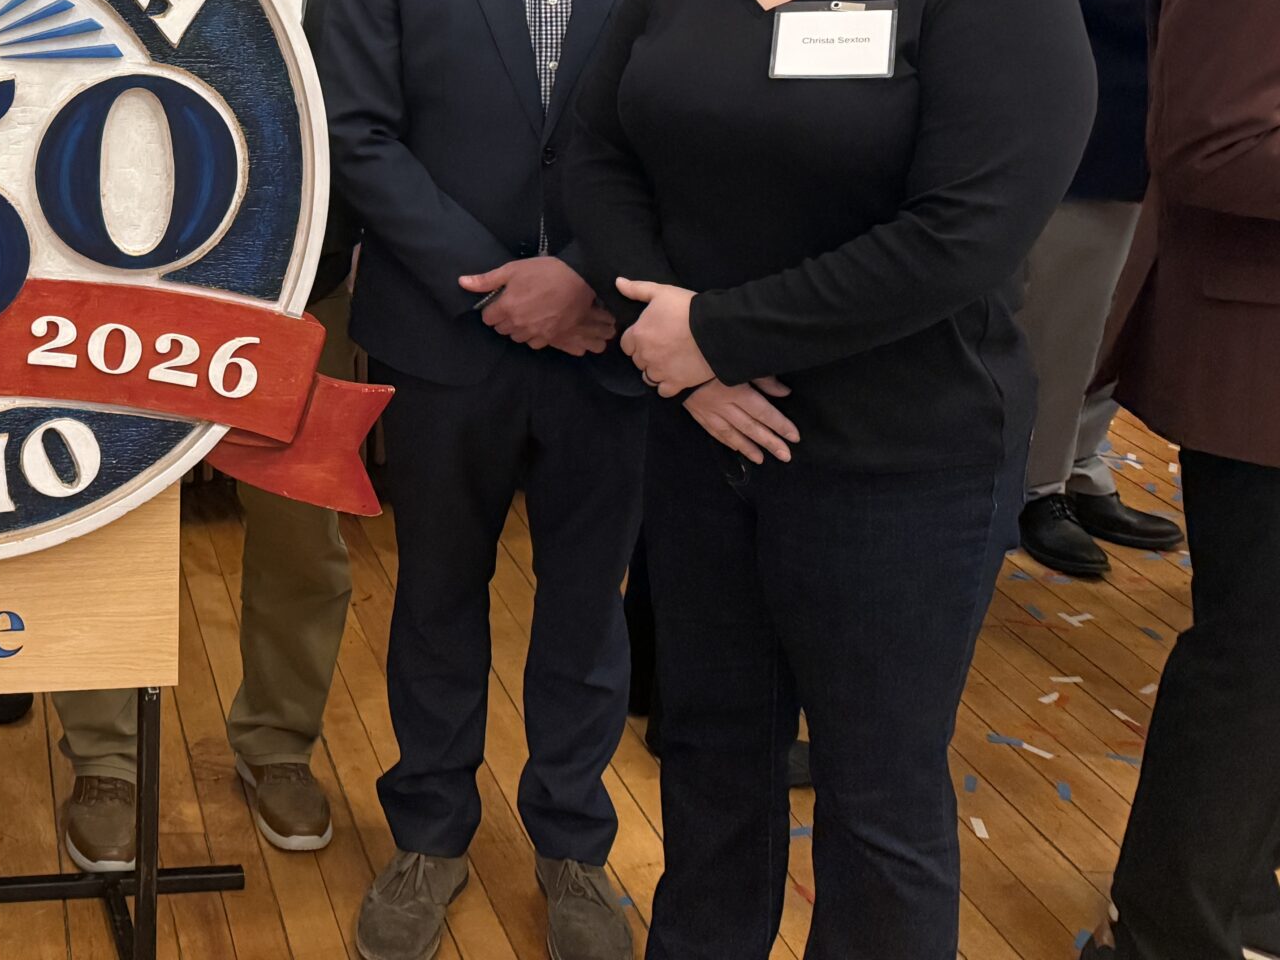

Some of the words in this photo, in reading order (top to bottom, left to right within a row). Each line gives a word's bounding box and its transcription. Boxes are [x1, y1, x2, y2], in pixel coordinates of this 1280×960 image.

[802, 37, 835, 45] Christa
[837, 36, 871, 44] Sexton
[27, 315, 261, 399] 2026
